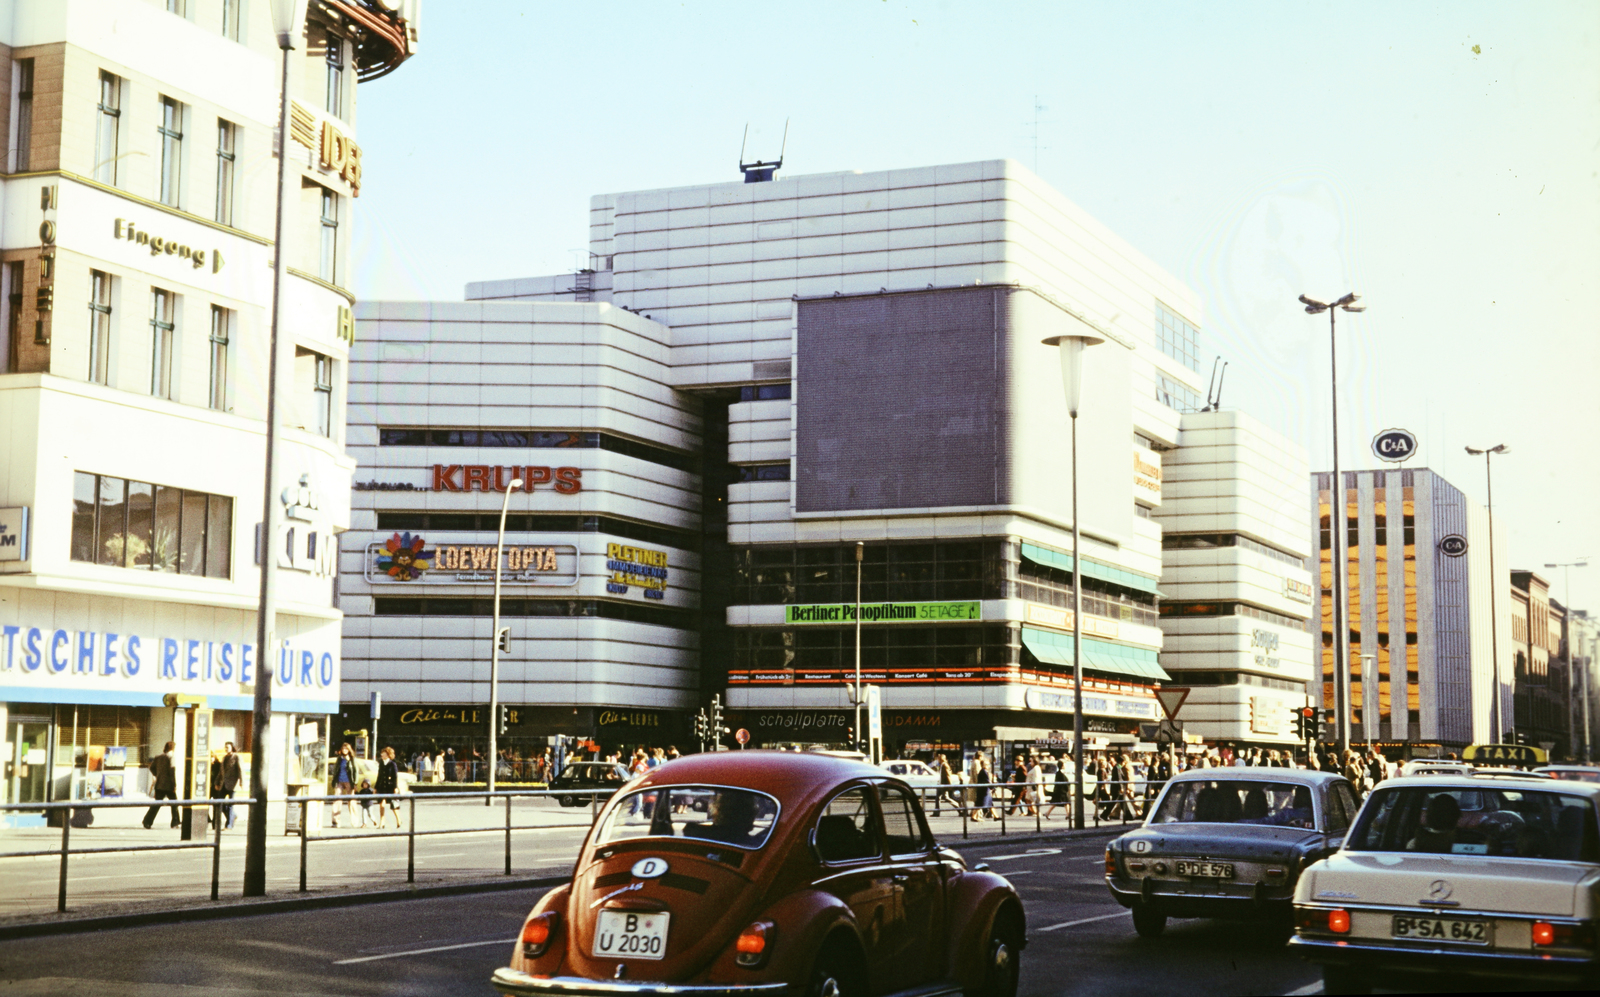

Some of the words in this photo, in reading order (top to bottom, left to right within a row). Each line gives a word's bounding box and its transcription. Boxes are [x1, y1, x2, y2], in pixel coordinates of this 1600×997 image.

[114, 218, 205, 270] Eingang
[34, 185, 58, 345] HOTEL
[1381, 438, 1409, 453] C&A
[432, 464, 582, 494] KRUPS
[255, 522, 337, 579] KLM
[607, 542, 668, 568] PLETTNER
[1445, 541, 1462, 550] C&A
[508, 547, 557, 571] OPTA
[791, 604, 840, 621] Berliner
[842, 603, 917, 622] Panoptikum
[2, 624, 141, 678] TSCHES
[158, 636, 333, 688] REISEÜRO
[443, 710, 457, 719] in
[461, 710, 519, 724] LER
[759, 712, 846, 729] schallplatte
[882, 715, 941, 726] UDAMM
[1483, 747, 1526, 760] TAXI
[1137, 841, 1146, 852] D
[643, 861, 656, 875] D
[1177, 863, 1186, 875] B
[1211, 864, 1232, 877] 576
[625, 914, 638, 933] B
[1396, 918, 1410, 936] B
[1418, 920, 1446, 939] SA
[1451, 922, 1485, 941] 642
[600, 933, 614, 951] U
[618, 934, 661, 954] 2030
